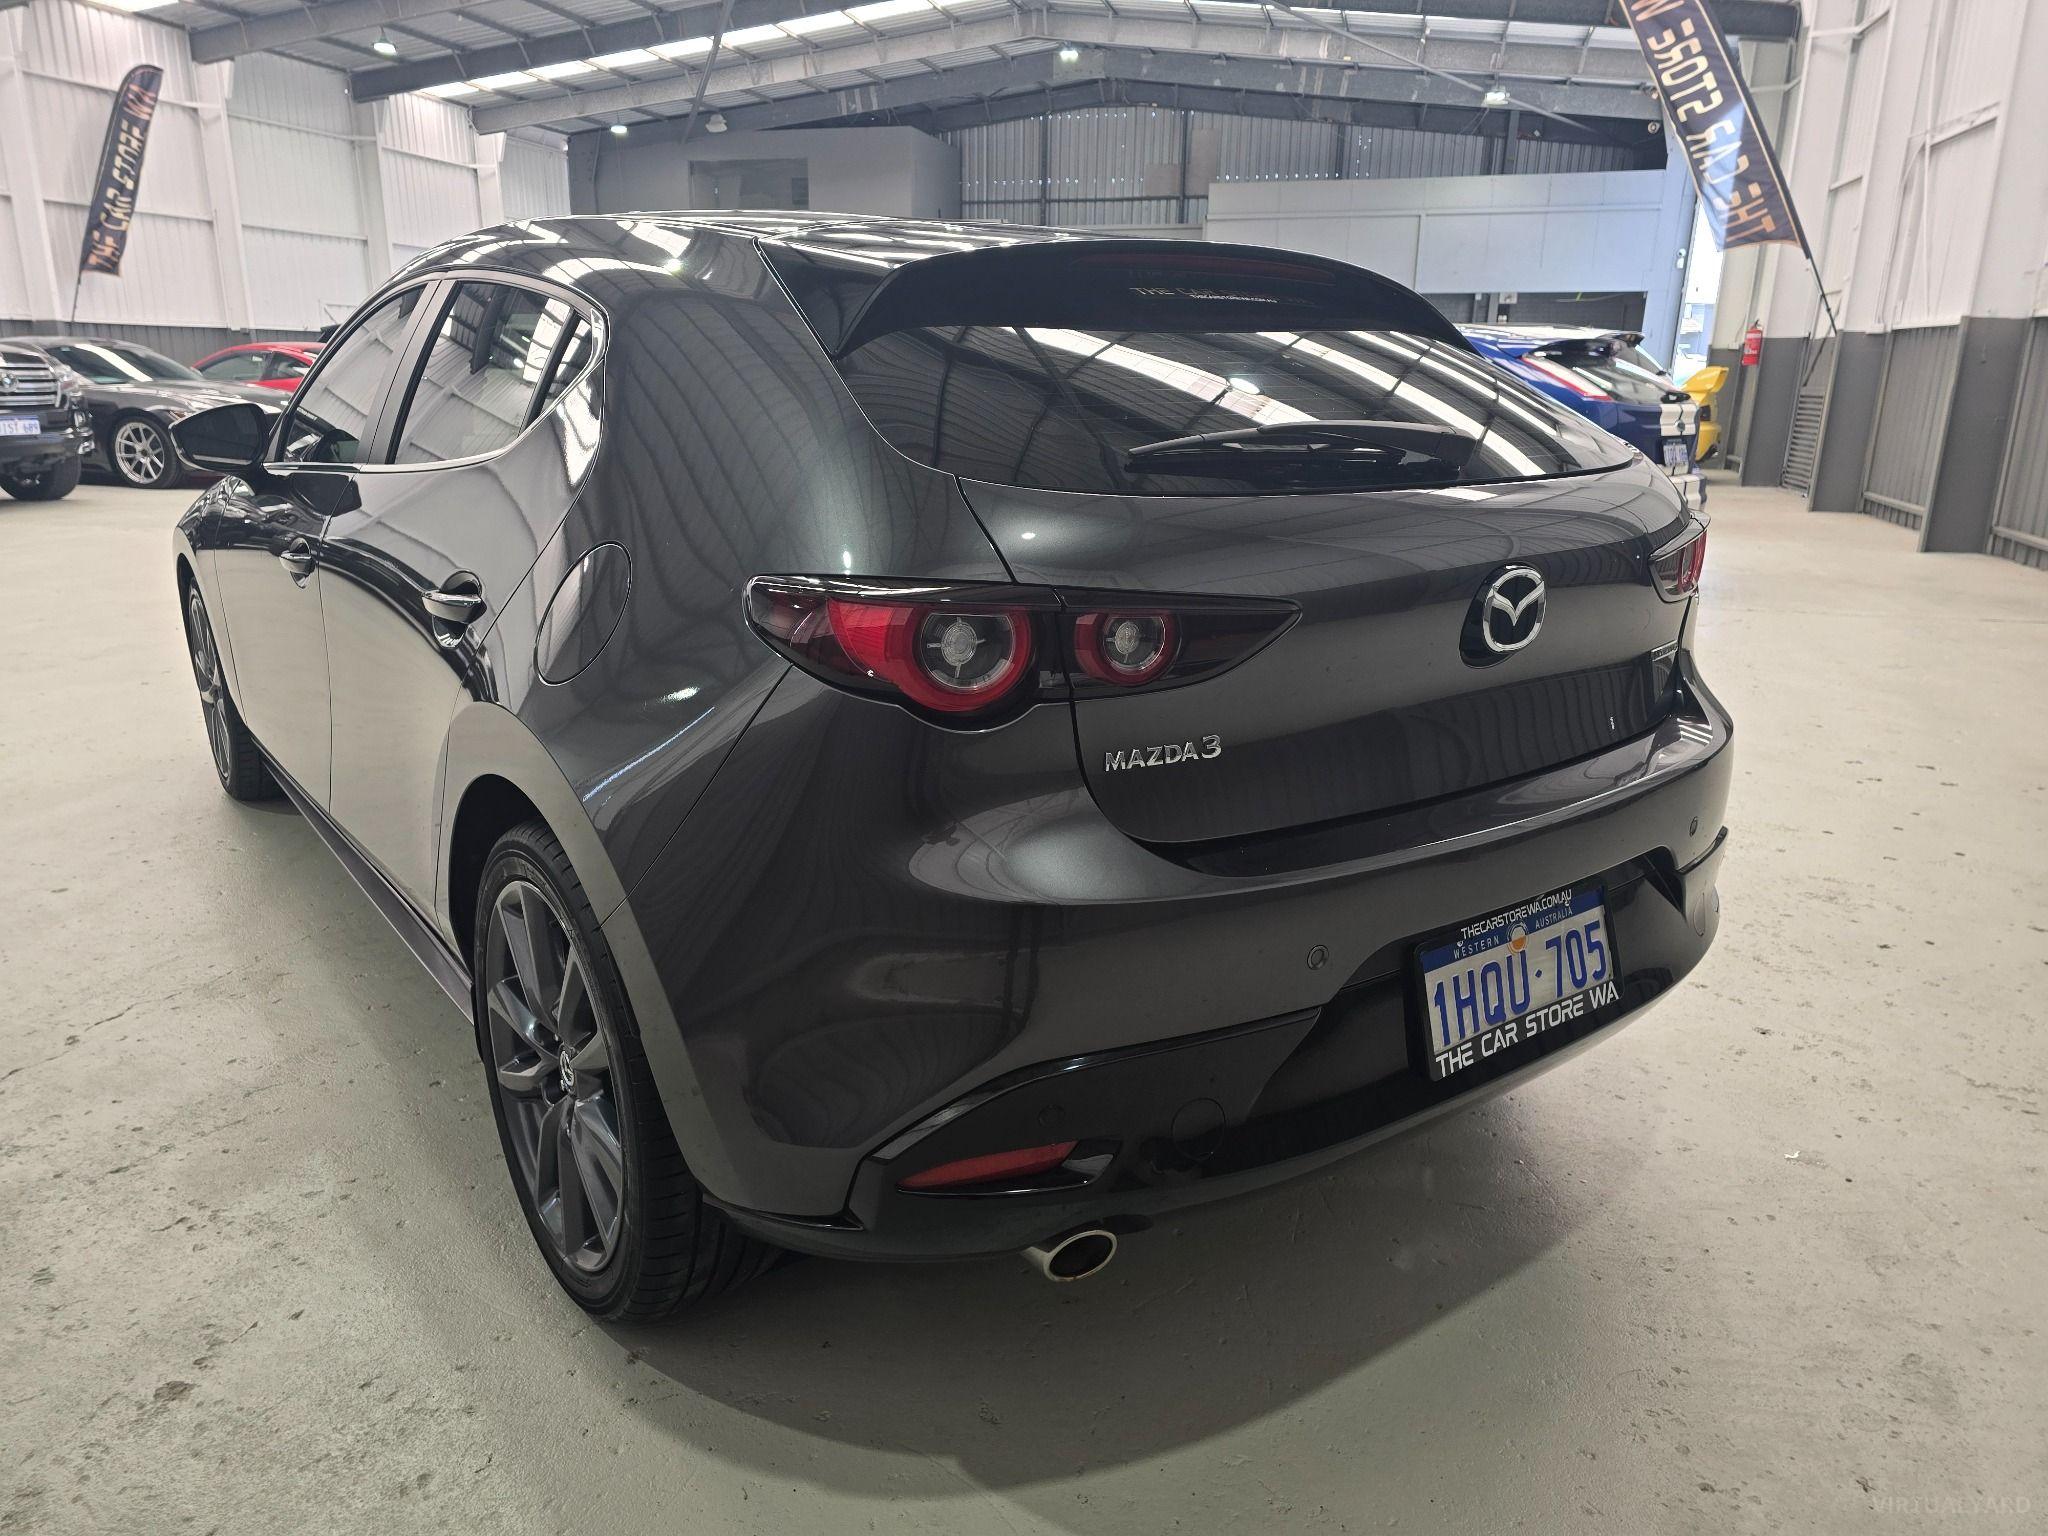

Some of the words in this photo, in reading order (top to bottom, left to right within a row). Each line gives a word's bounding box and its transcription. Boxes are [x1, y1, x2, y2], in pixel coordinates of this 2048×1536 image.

[112, 120, 146, 190] STORE
[100, 187, 132, 232] CAR
[88, 229, 121, 270] THE
[1453, 935, 1500, 959] WESTERN
[1535, 907, 1573, 930] AUSTRALIA
[1436, 1042, 1474, 1078] THE
[1481, 1022, 1519, 1057] CAR
[1526, 994, 1584, 1038] STORE
[1589, 981, 1620, 1010] WA
